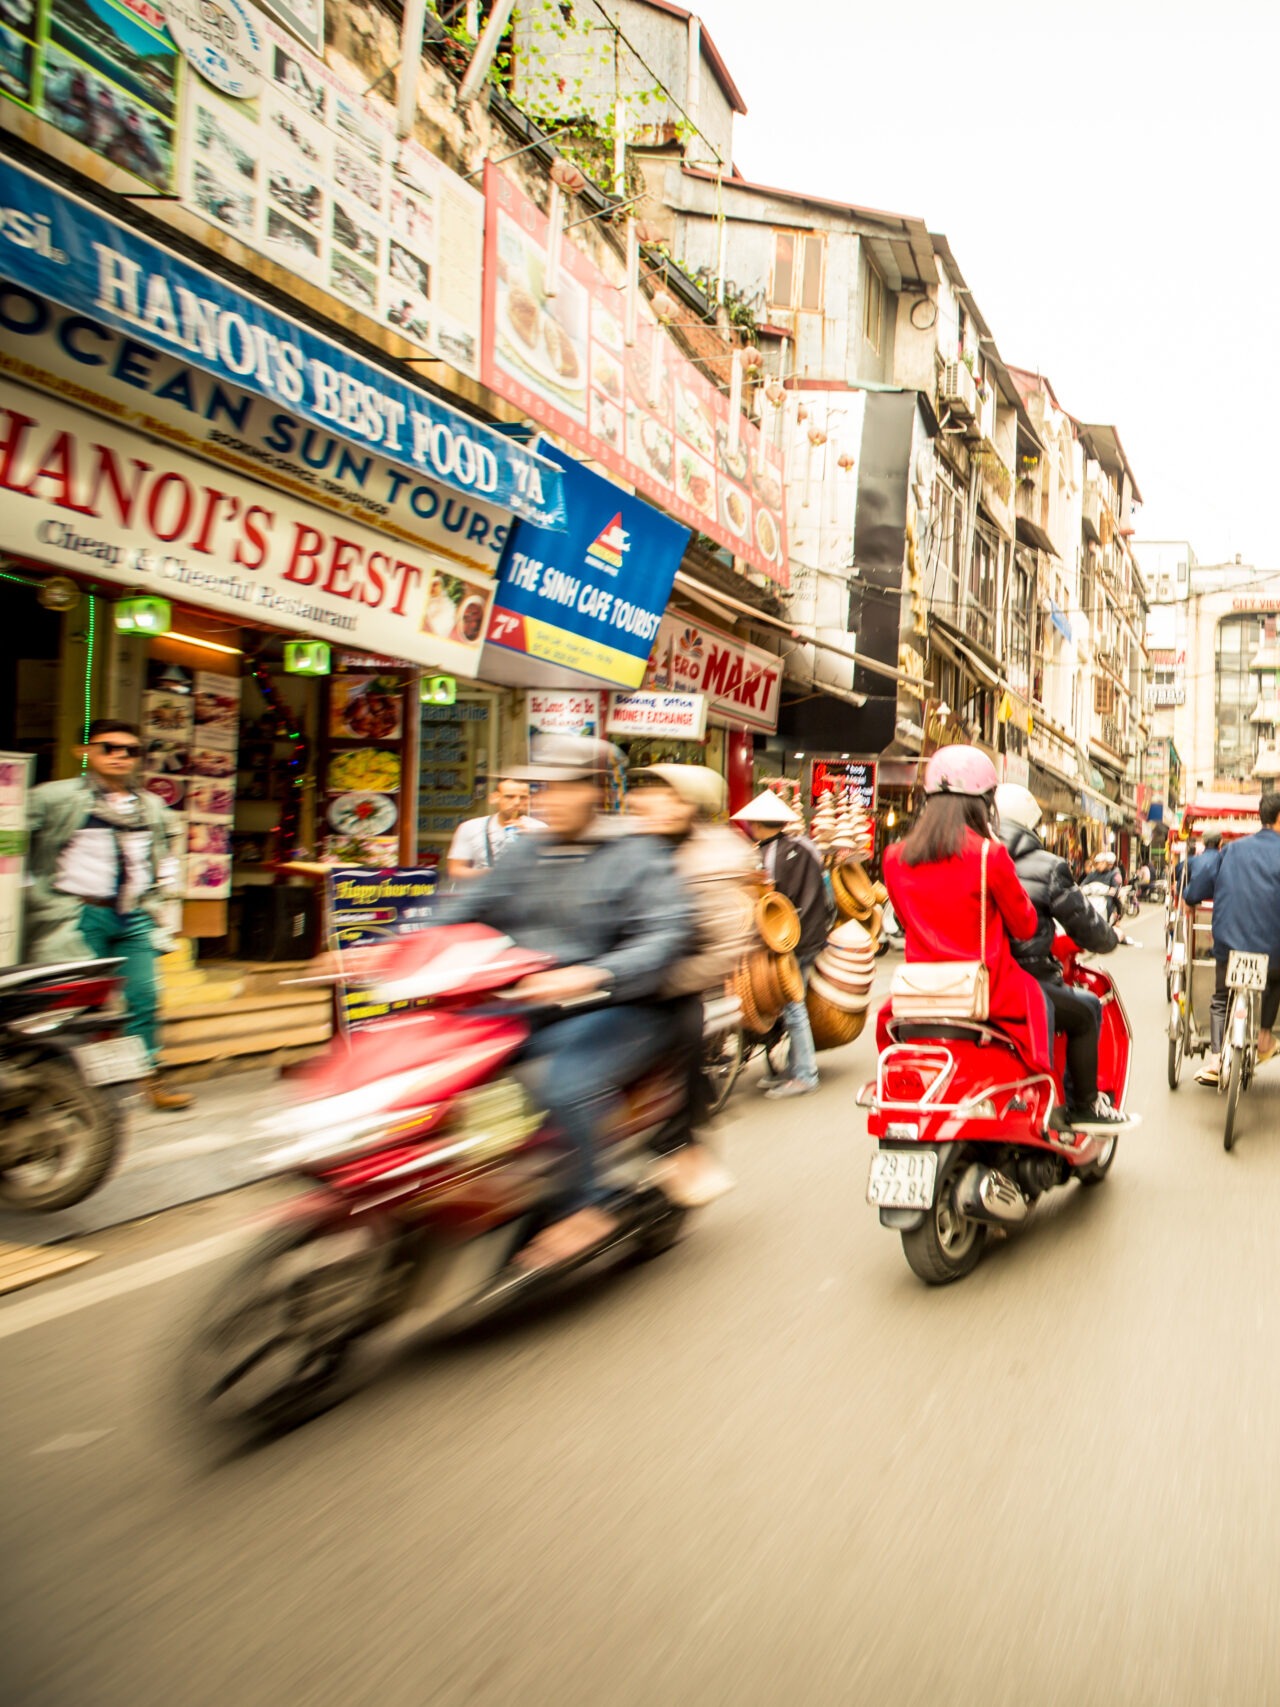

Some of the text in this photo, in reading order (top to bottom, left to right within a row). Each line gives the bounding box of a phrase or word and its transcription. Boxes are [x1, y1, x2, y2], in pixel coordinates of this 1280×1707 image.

[0, 282, 253, 433] OCEAN
[262, 413, 373, 489] SUN
[385, 469, 509, 553] TOURS
[91, 241, 305, 402] HANOI'S
[309, 358, 406, 451] BEST
[410, 410, 499, 494] FOOD
[506, 455, 546, 505] 7A
[259, 585, 359, 632] Restaurant
[281, 521, 424, 617] BEST
[508, 551, 544, 592] THE
[538, 567, 581, 608] SINH
[577, 584, 614, 623] CAFE
[609, 598, 662, 642] TOURIST
[701, 643, 778, 713] MART
